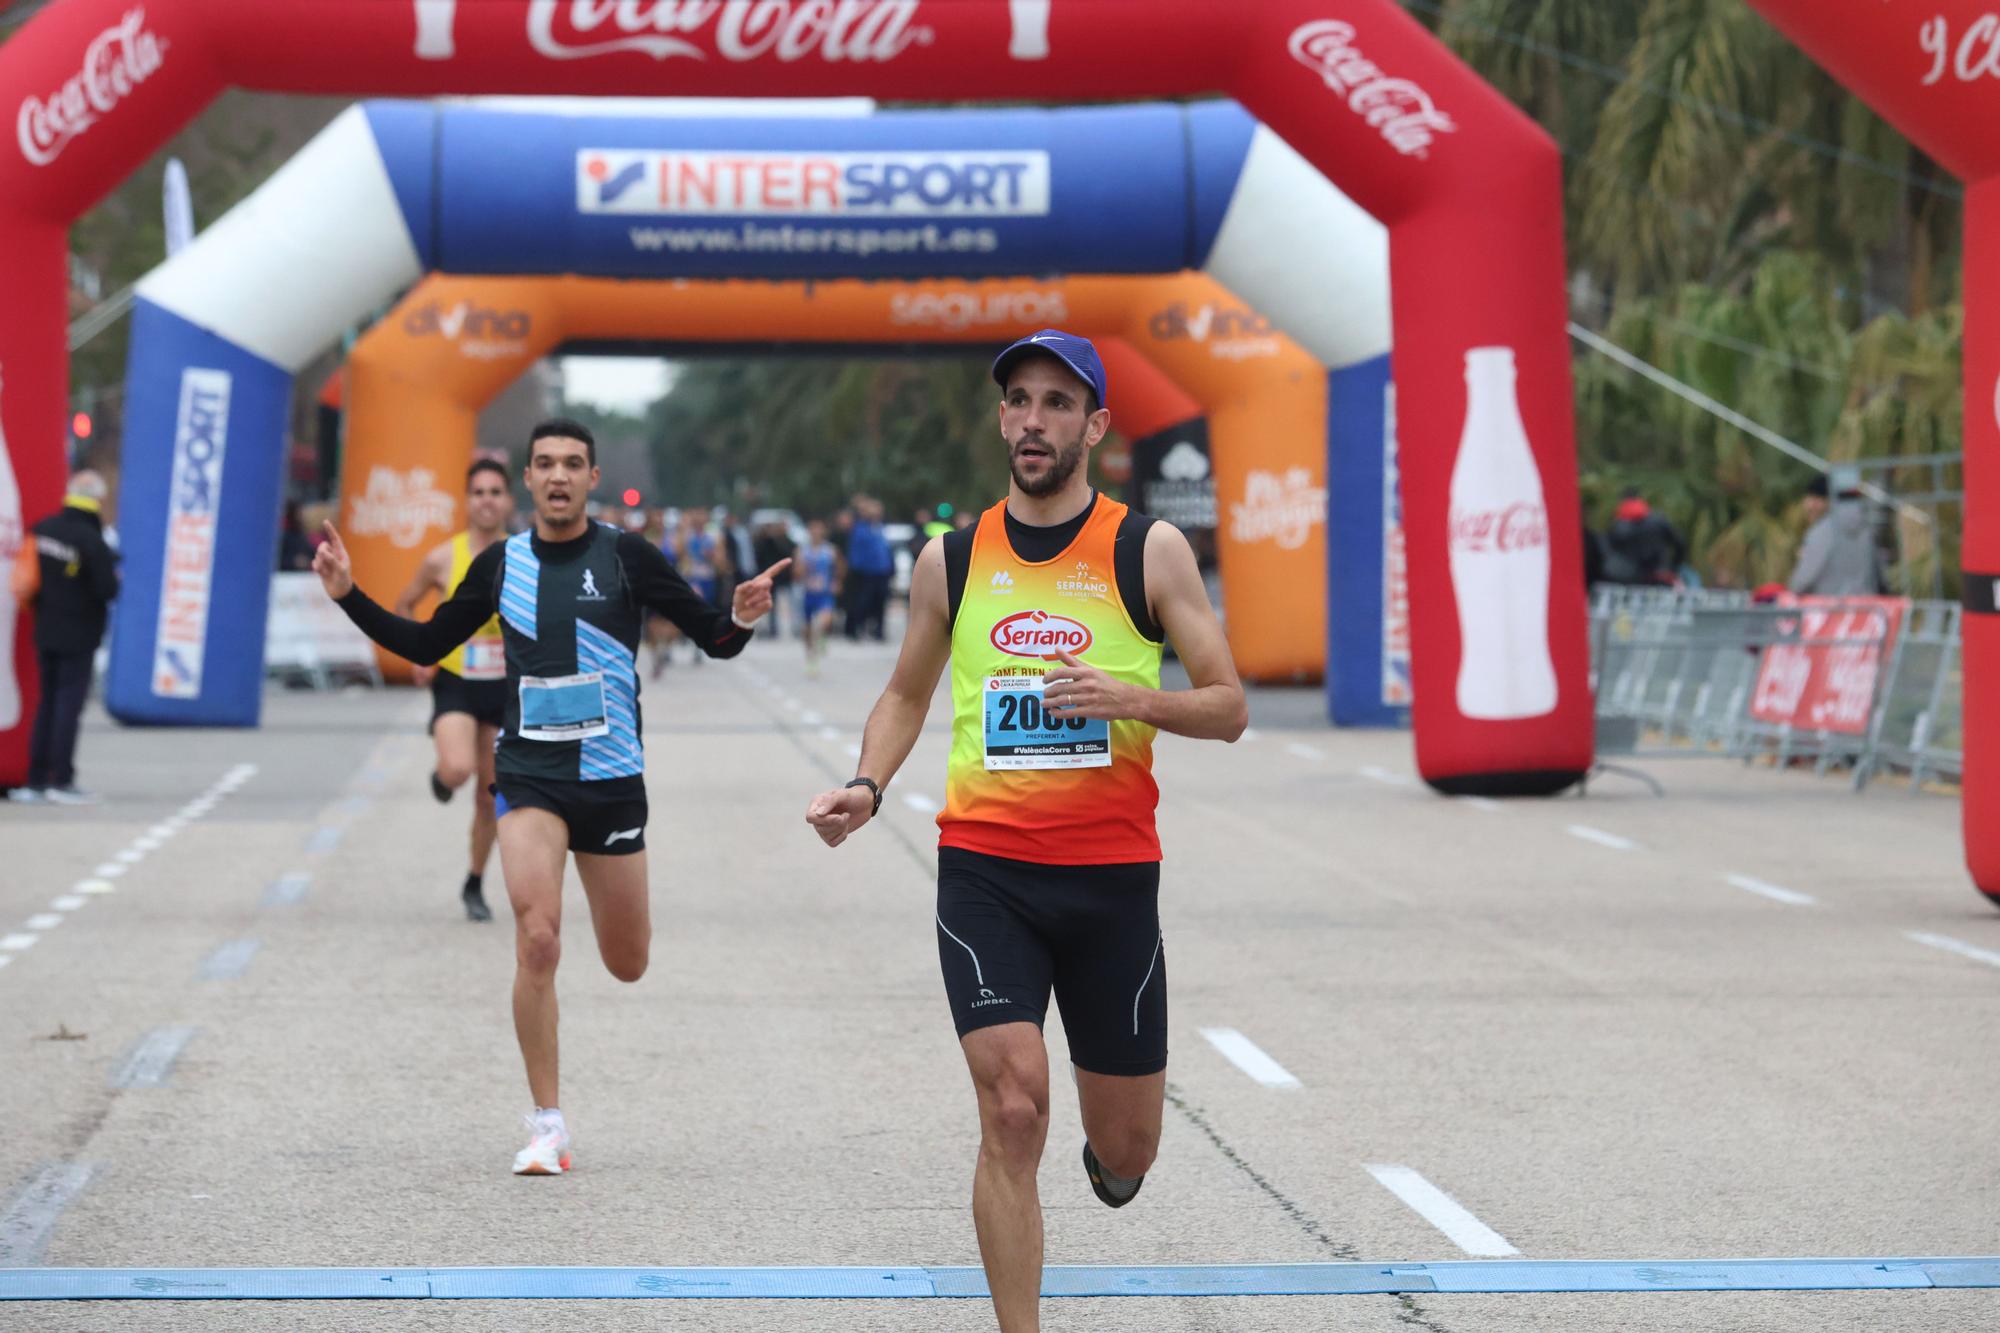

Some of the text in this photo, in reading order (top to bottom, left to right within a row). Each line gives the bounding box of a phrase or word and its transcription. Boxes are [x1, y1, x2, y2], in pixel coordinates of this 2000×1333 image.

[657, 158, 1029, 207] INTERSPORT
[630, 224, 998, 256] www.intersport.es
[890, 290, 1068, 329] seguros
[163, 386, 221, 644] INTERSPORT
[1056, 581, 1107, 593] SERRANO
[1000, 624, 1083, 646] Serrano
[1014, 746, 1071, 754] #ValènciaCorre
[971, 998, 1012, 1008] LURBEL
